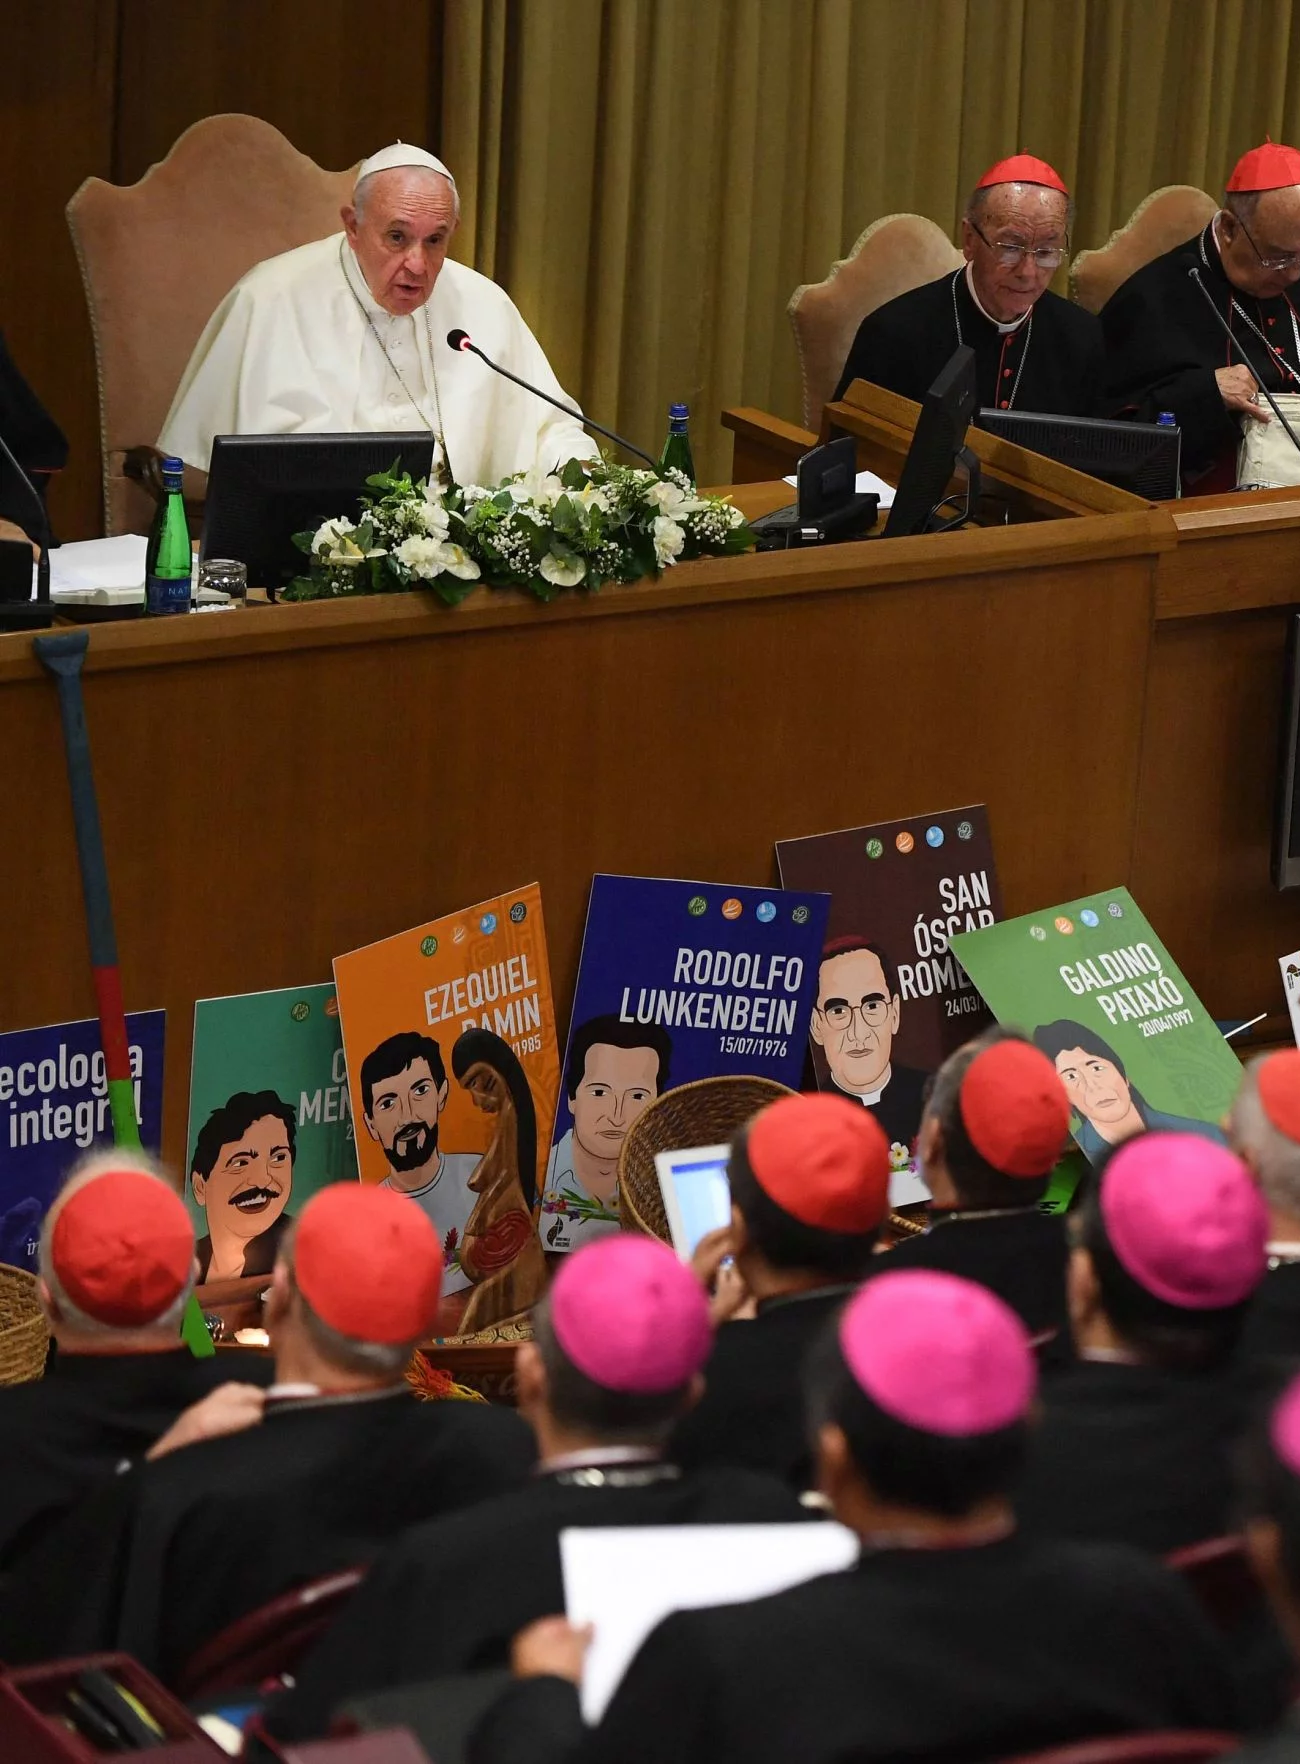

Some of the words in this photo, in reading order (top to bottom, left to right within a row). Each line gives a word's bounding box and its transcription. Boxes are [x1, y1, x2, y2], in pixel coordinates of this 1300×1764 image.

[938, 870, 992, 914] SAN
[424, 953, 538, 1026] EZEQUIEL
[673, 947, 804, 993] RODOLFO
[897, 955, 974, 1001] ROME
[1059, 942, 1162, 996] GALDINO
[619, 986, 798, 1036] LUNKENBEIN
[1095, 969, 1185, 1026] PATAXÓ
[719, 1035, 788, 1058] 15/07/1976
[1137, 1008, 1195, 1038] 20/04/1997
[0, 1043, 143, 1101] ecologa
[10, 1079, 143, 1148] integrl
